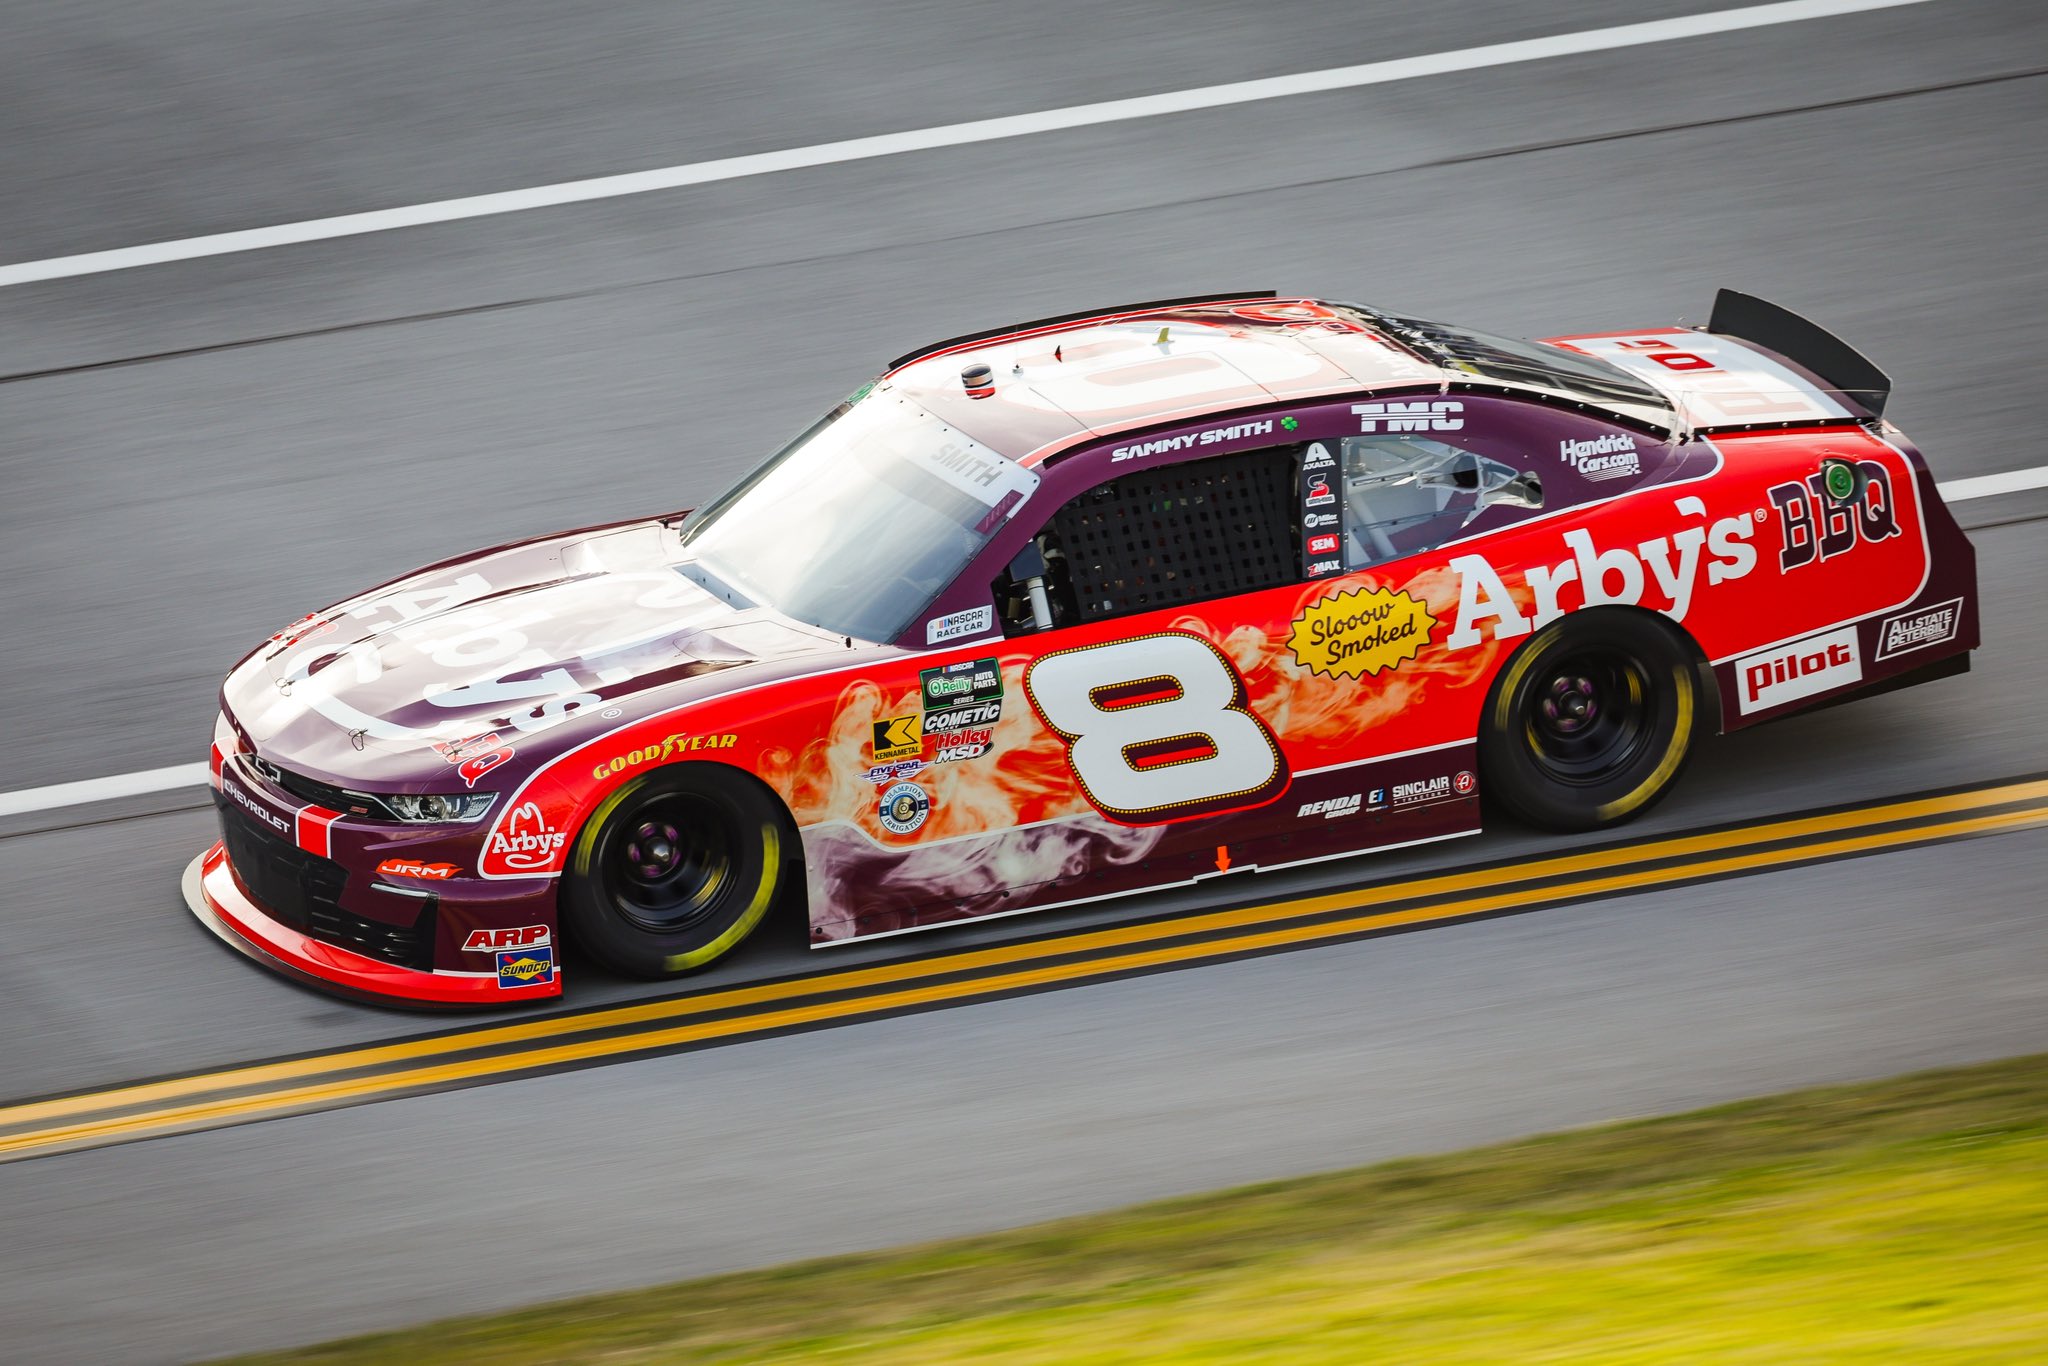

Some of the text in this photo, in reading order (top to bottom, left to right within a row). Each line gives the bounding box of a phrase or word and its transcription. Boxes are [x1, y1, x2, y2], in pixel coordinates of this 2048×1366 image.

[1351, 402, 1464, 431] TMC
[1111, 419, 1273, 463] SAMMY SMITH
[1560, 434, 1636, 466] Hendrick
[929, 443, 1003, 487] SMITH
[1303, 459, 1336, 471] AXALTA
[1578, 453, 1639, 473] Cars.com
[1311, 538, 1335, 551] SEM
[1447, 496, 1757, 650] Arby's
[947, 610, 983, 626] NASCAR
[1310, 603, 1395, 646] Slooow
[1889, 609, 1952, 636] ALLSTATE
[937, 621, 983, 638] RACE CAR
[1326, 613, 1417, 665] Smoked
[1887, 620, 1951, 651] PETERBILT
[949, 662, 974, 672] NASCAR
[1746, 643, 1850, 702] pilot
[929, 671, 993, 697] O'Reilly AUTO
[974, 679, 997, 689] PARTS
[953, 696, 975, 705] SERIES
[925, 704, 1000, 731] COMETIC
[1024, 630, 1283, 818] 8
[936, 729, 992, 749] Holley
[875, 746, 920, 760] KENNAMETAL
[936, 744, 985, 764] MSD
[870, 765, 892, 777] FIVE
[896, 761, 919, 770] STAR
[884, 785, 923, 804] CHAMPION
[1392, 776, 1450, 798] SINCLAIR
[1402, 791, 1442, 803] TRACTOR
[224, 780, 290, 833] CHEVROLET
[1297, 794, 1361, 817] RENDA
[1325, 806, 1361, 819] GROUP
[884, 811, 925, 831] IRRIGATION
[492, 826, 565, 855] Arby's
[382, 864, 448, 878] JRM
[465, 926, 548, 947] ARP
[502, 962, 547, 975] SUNOCO
